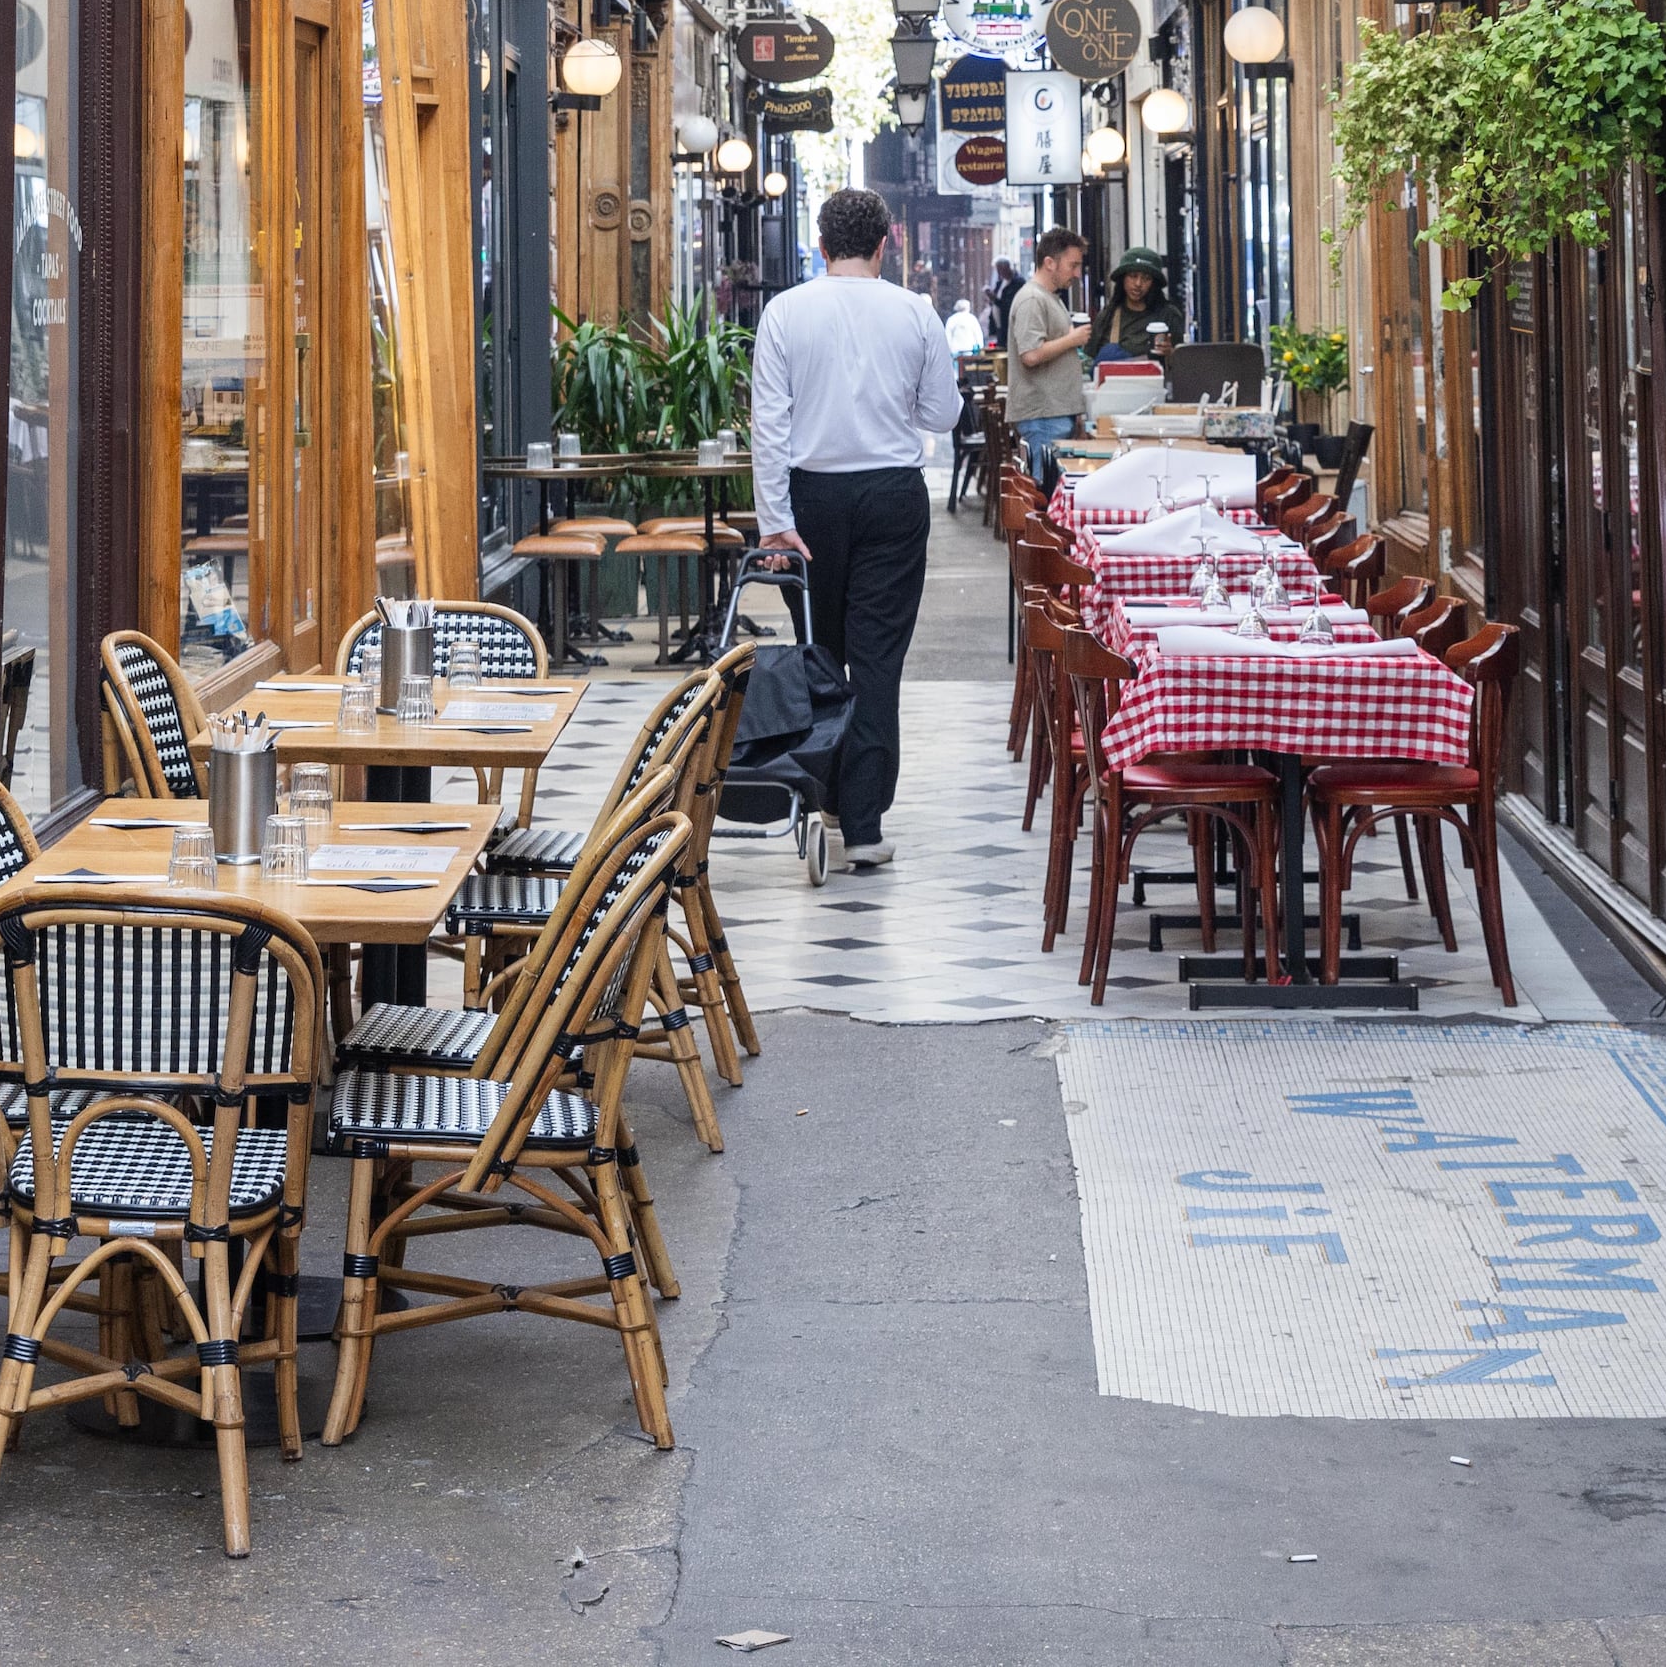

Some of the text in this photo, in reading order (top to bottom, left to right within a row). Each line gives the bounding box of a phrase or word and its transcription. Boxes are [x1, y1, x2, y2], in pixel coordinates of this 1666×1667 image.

[1083, 32, 1133, 61] ONE
[945, 82, 1005, 99] VICTORI
[764, 100, 812, 115] Phila2000
[951, 106, 1005, 123] STATIO
[66, 200, 83, 252] FOOD
[41, 252, 60, 279] TAPAS
[33, 297, 67, 327] COCKTAILS
[1286, 1089, 1662, 1389] WATERMAN
